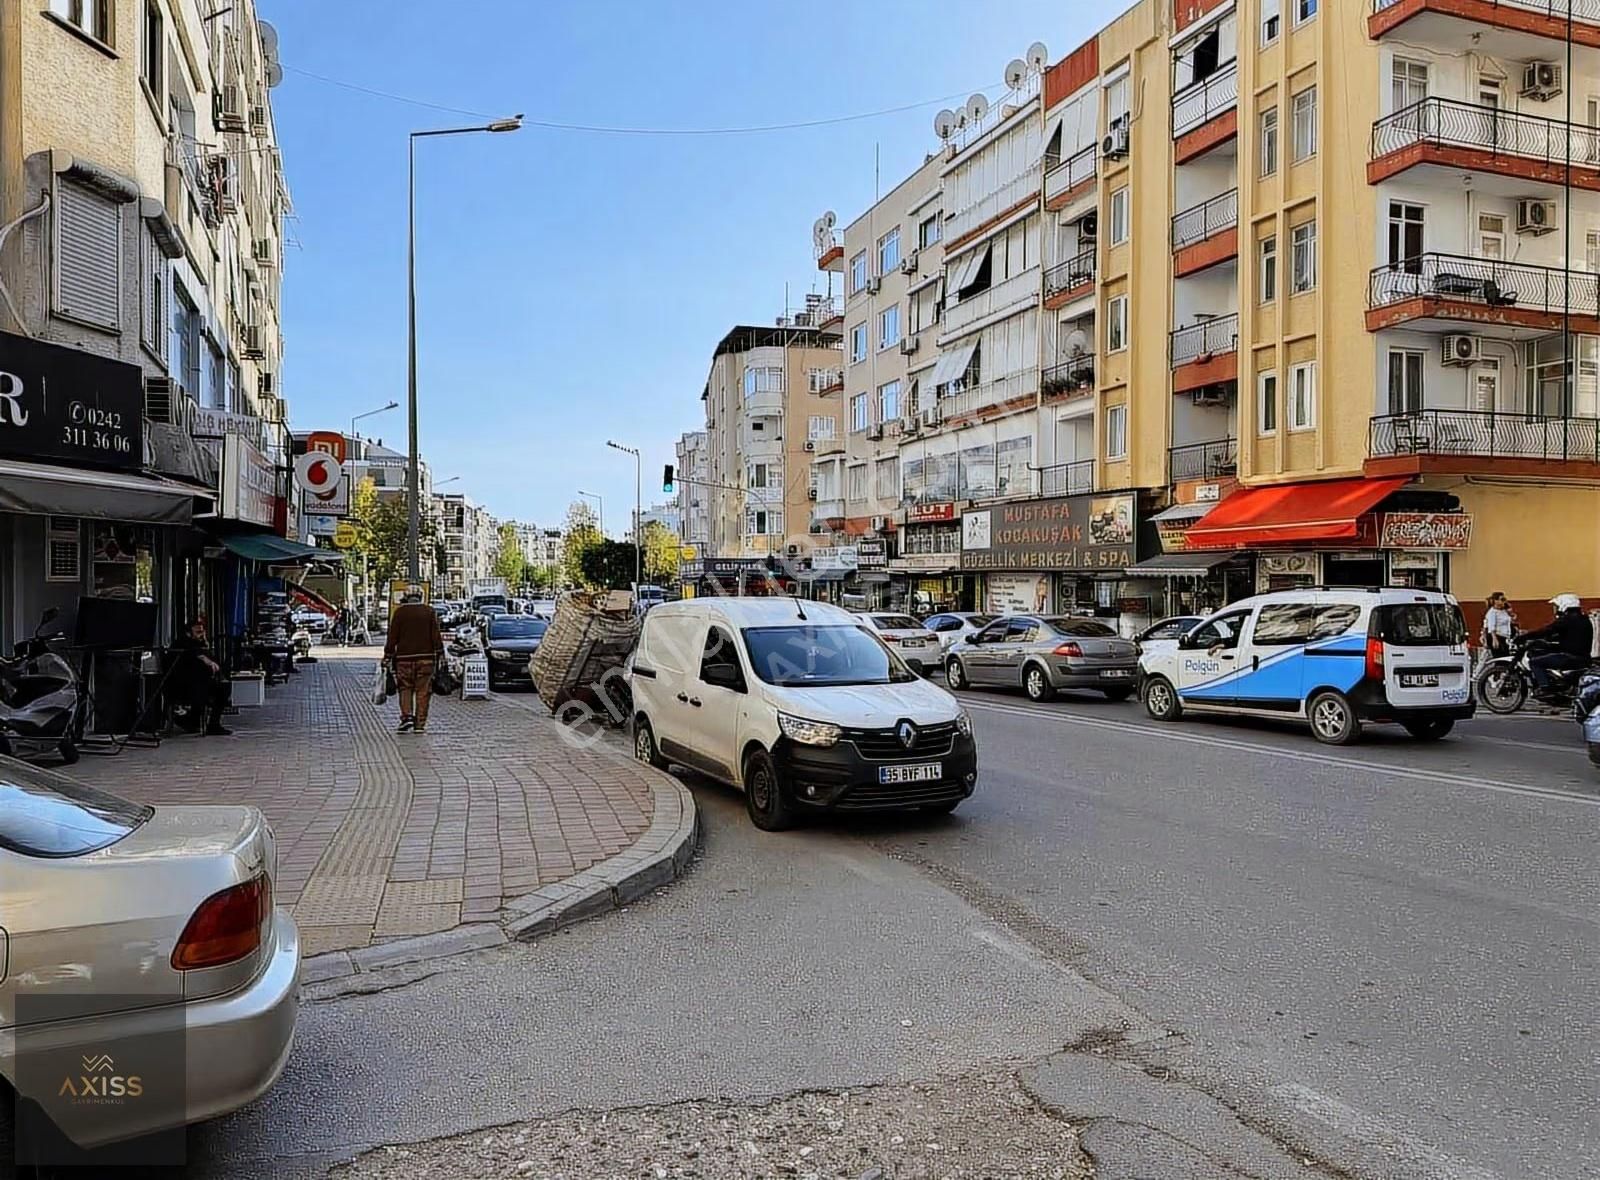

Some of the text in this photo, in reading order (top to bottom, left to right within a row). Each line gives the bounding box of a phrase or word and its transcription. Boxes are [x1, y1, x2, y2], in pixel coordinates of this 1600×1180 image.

[88, 408, 121, 429] 0242
[62, 426, 130, 453] 311 36 06
[1004, 503, 1070, 523] MUSTAFA
[1020, 547, 1077, 567] MERKEZİ
[1084, 551, 1093, 567] &
[1099, 551, 1130, 567] SPA
[1185, 659, 1219, 675] Polgün
